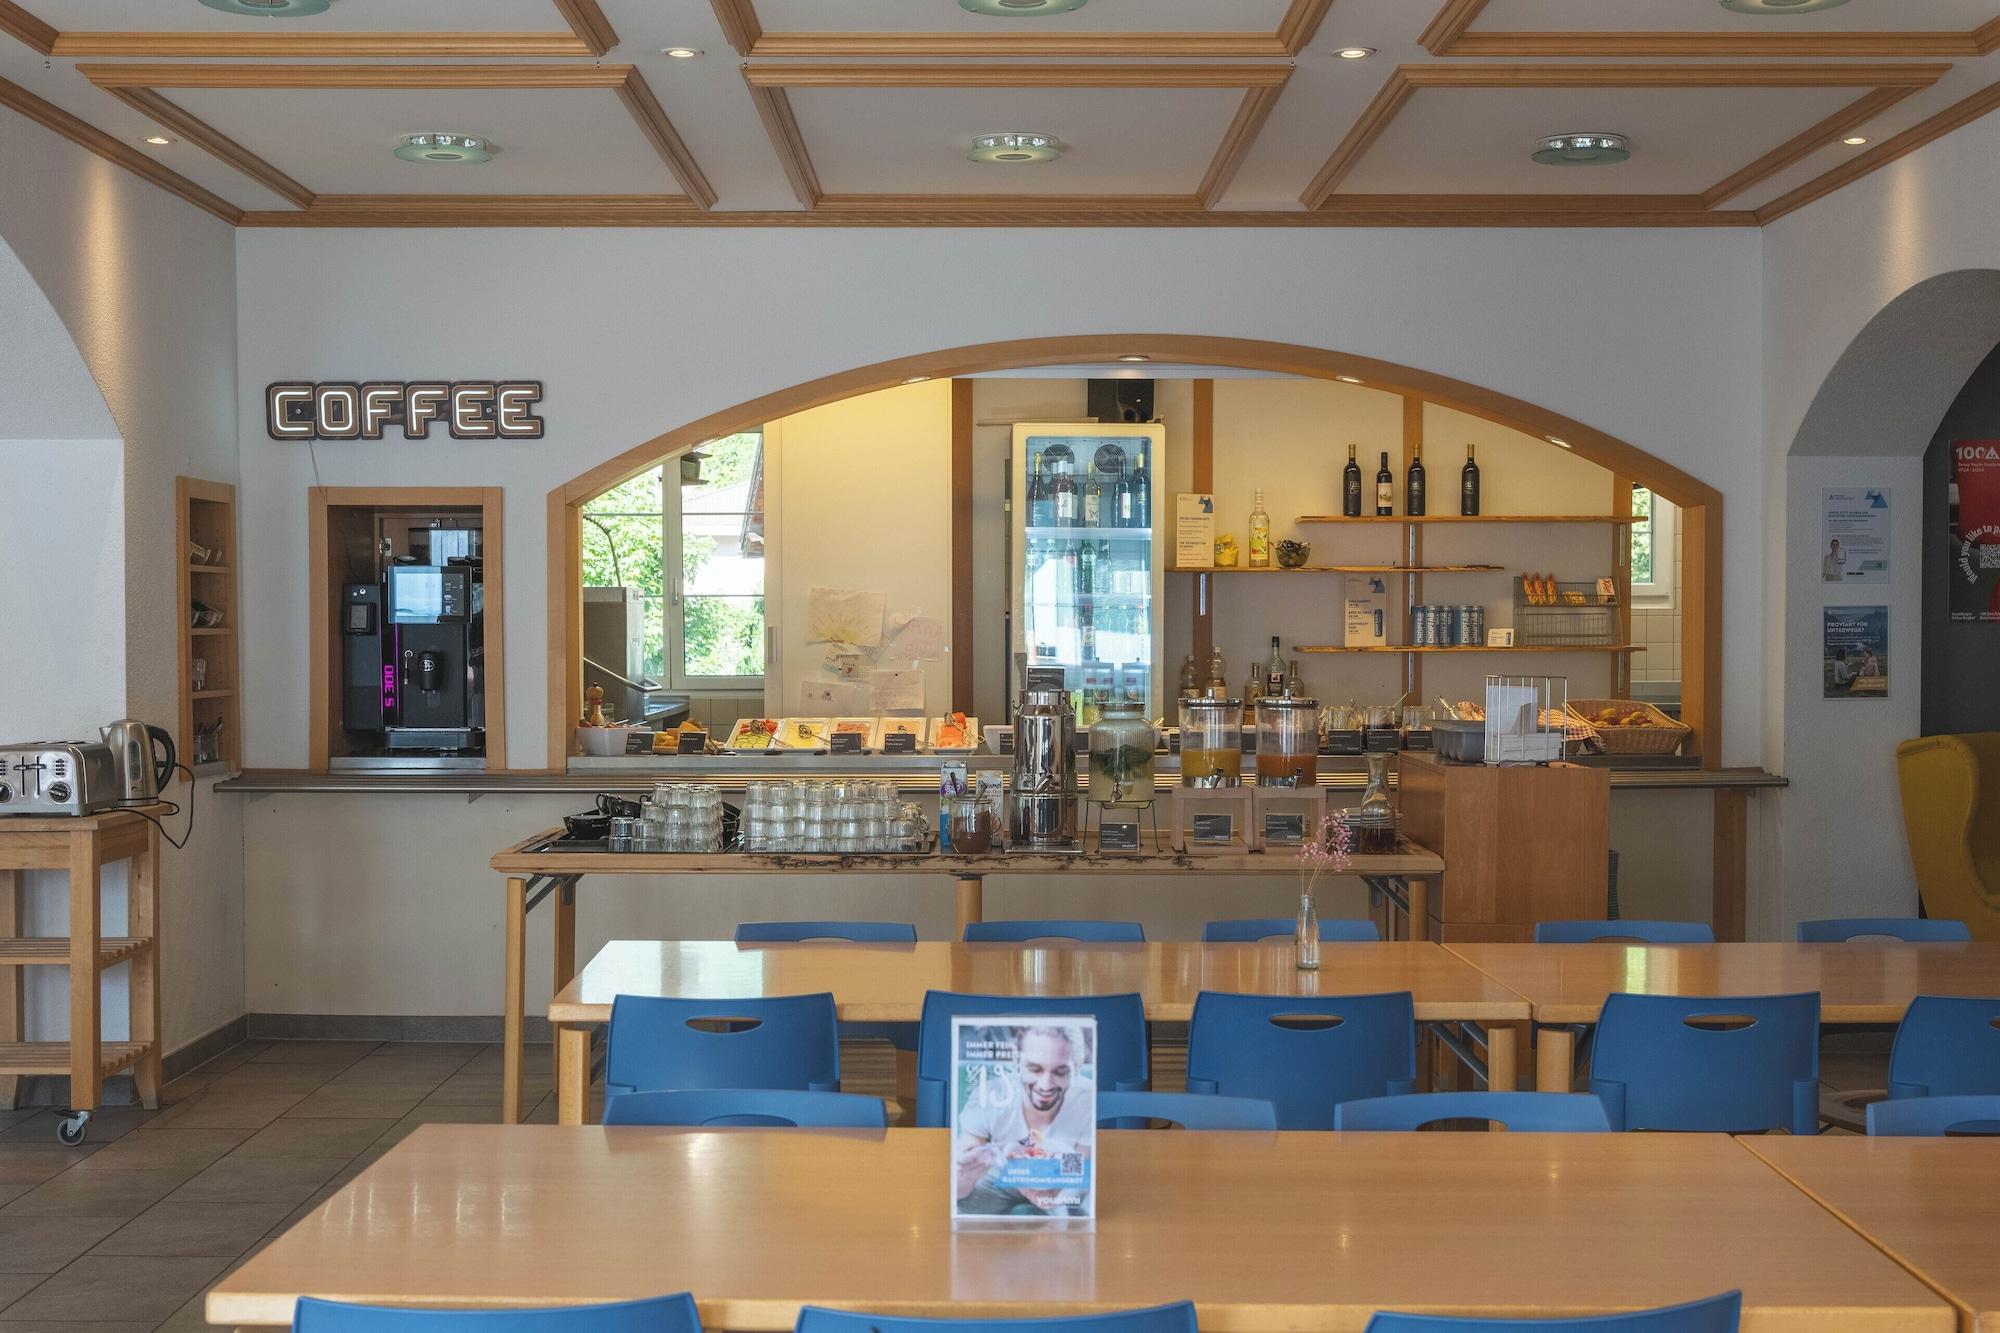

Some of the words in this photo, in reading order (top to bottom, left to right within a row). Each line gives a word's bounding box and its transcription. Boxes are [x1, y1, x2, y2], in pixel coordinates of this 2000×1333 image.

[268, 383, 542, 437] COFFEE
[1966, 527, 1983, 542] like
[1983, 524, 1993, 533] to
[1960, 540, 1972, 558] you
[1958, 558, 1978, 584] Would
[1427, 612, 1435, 643] CHOPFAB
[966, 1040, 994, 1049] IMMER
[966, 1050, 994, 1059] IMMER
